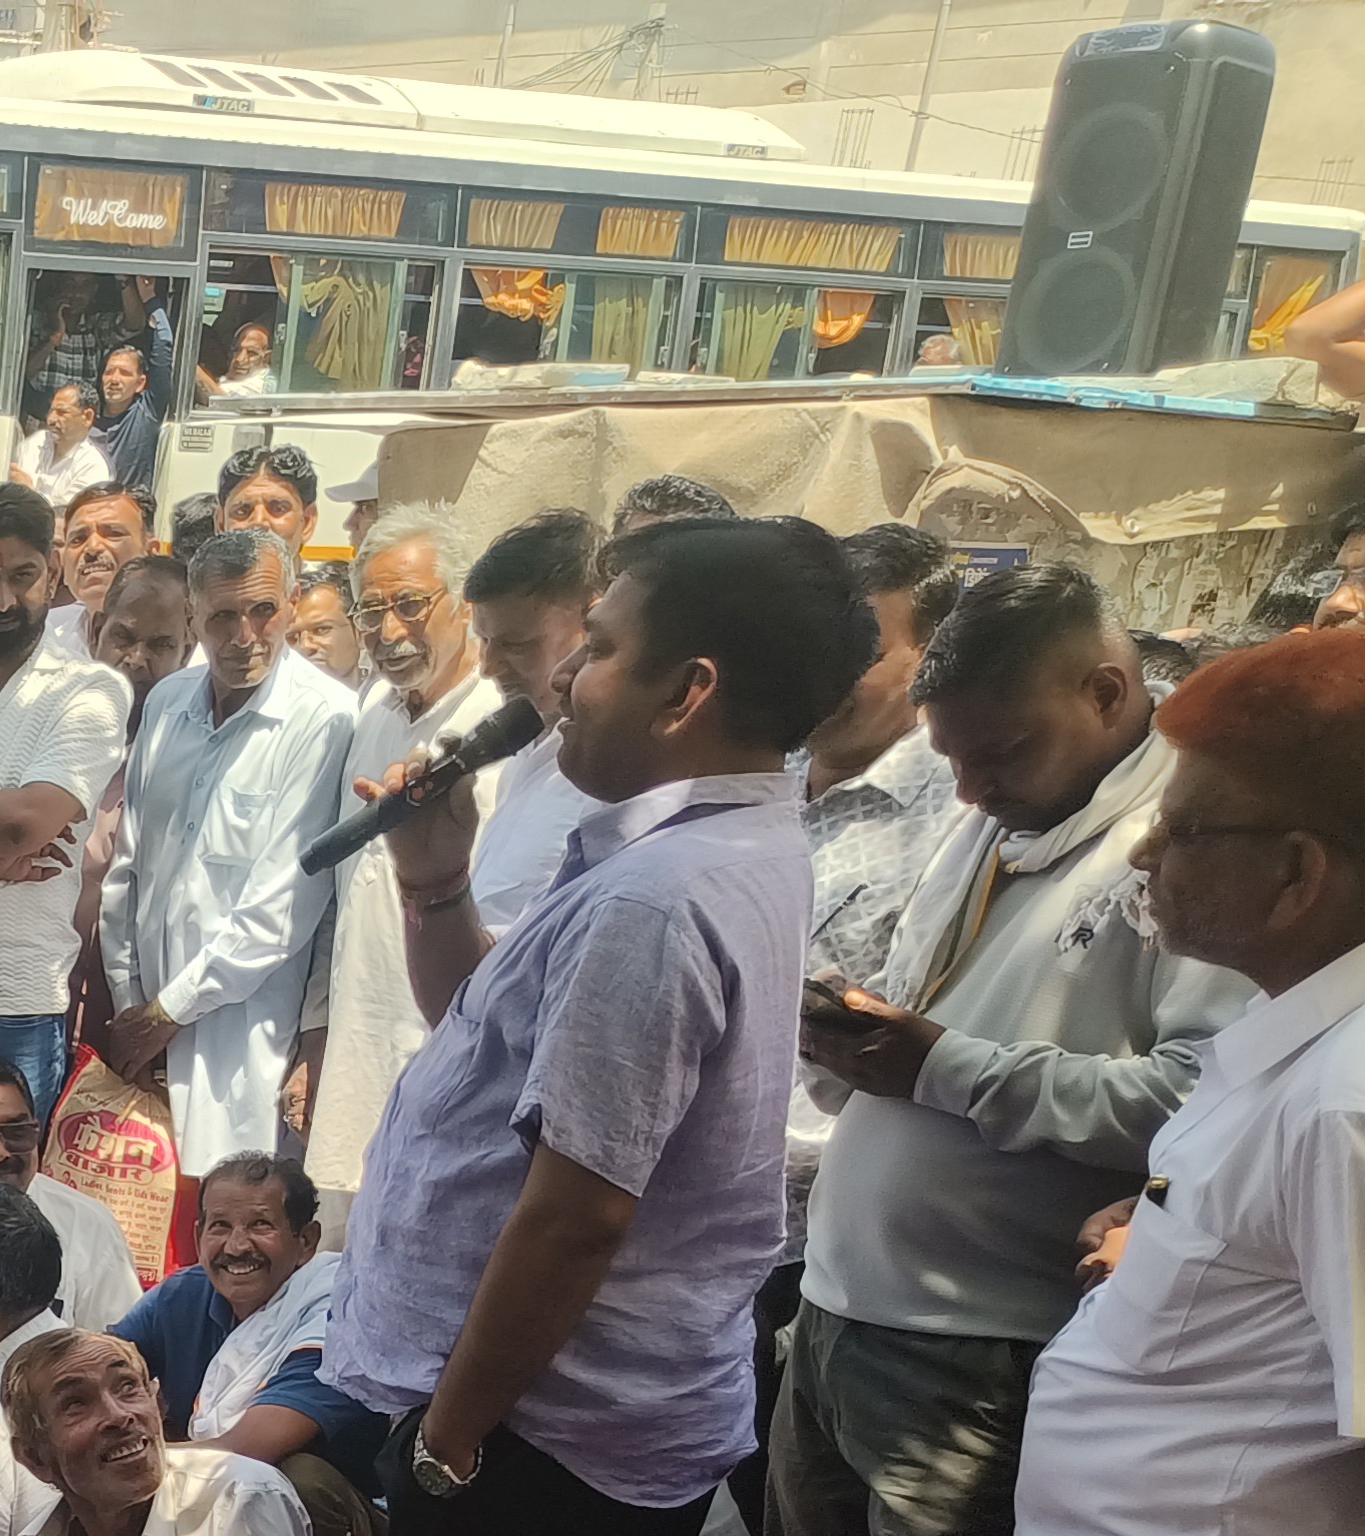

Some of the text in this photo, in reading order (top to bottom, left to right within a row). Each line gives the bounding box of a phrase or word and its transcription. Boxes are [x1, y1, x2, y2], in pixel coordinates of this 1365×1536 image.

[211, 98, 249, 112] JTAC
[729, 145, 763, 158] JTAC
[73, 1115, 158, 1167] फैशन
[66, 1154, 149, 1181] बाजार
